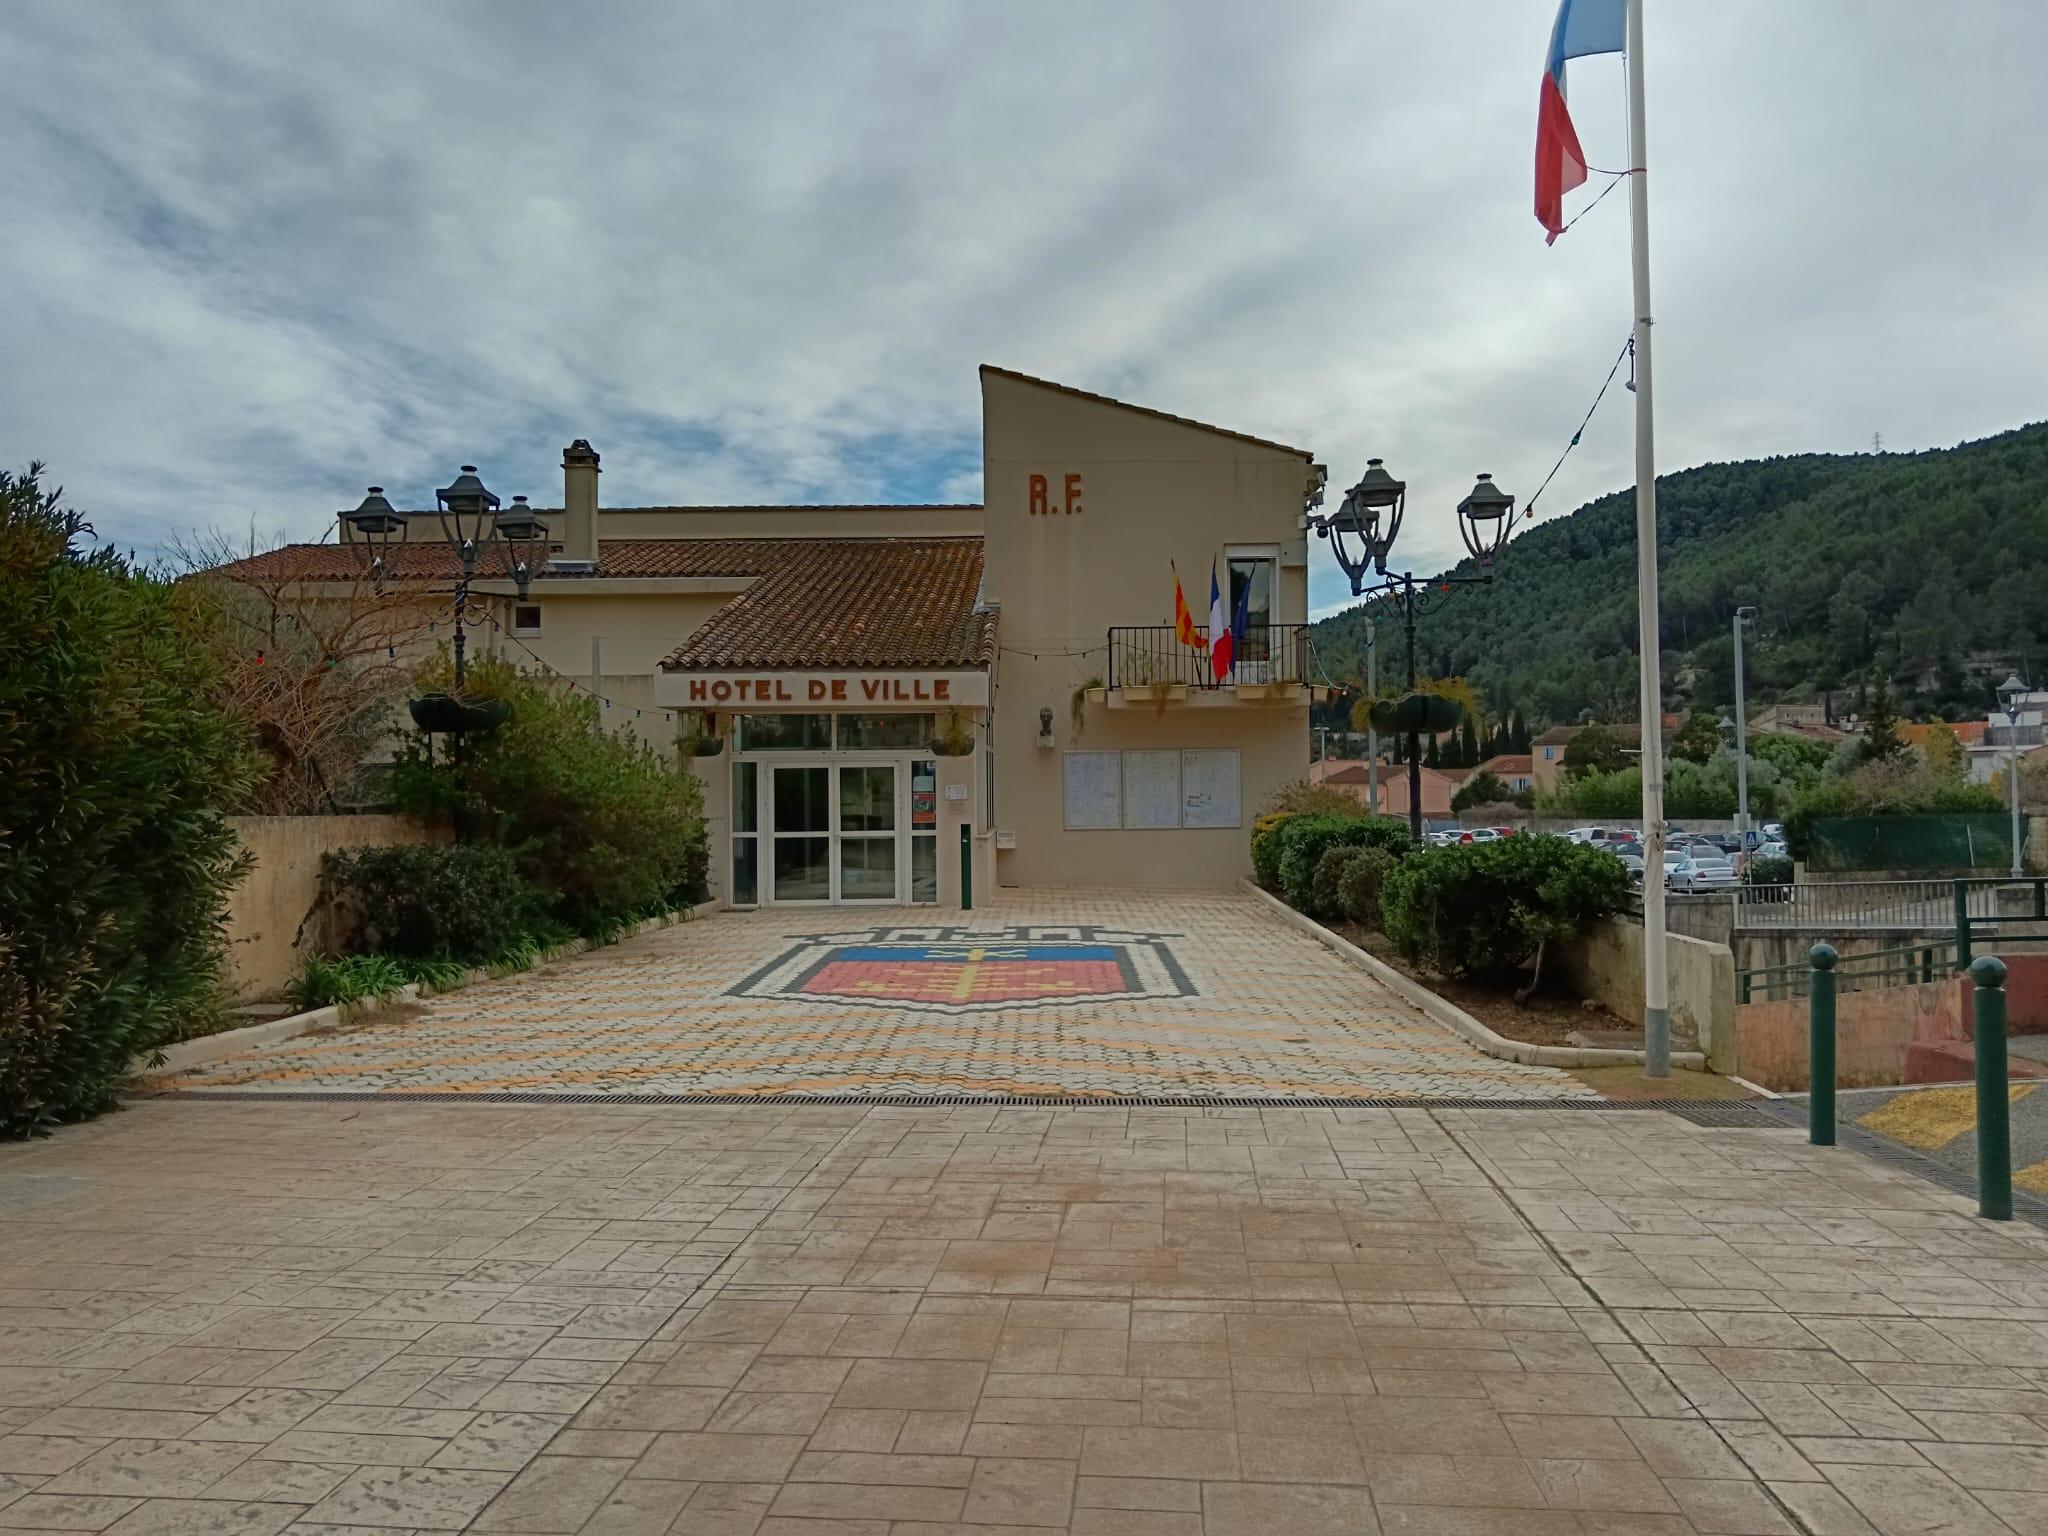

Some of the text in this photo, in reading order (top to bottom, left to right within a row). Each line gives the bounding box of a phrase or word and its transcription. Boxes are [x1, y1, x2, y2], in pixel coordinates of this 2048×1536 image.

[1029, 474, 1083, 515] R.F.
[689, 679, 950, 701] HOTEL DE VILLE
